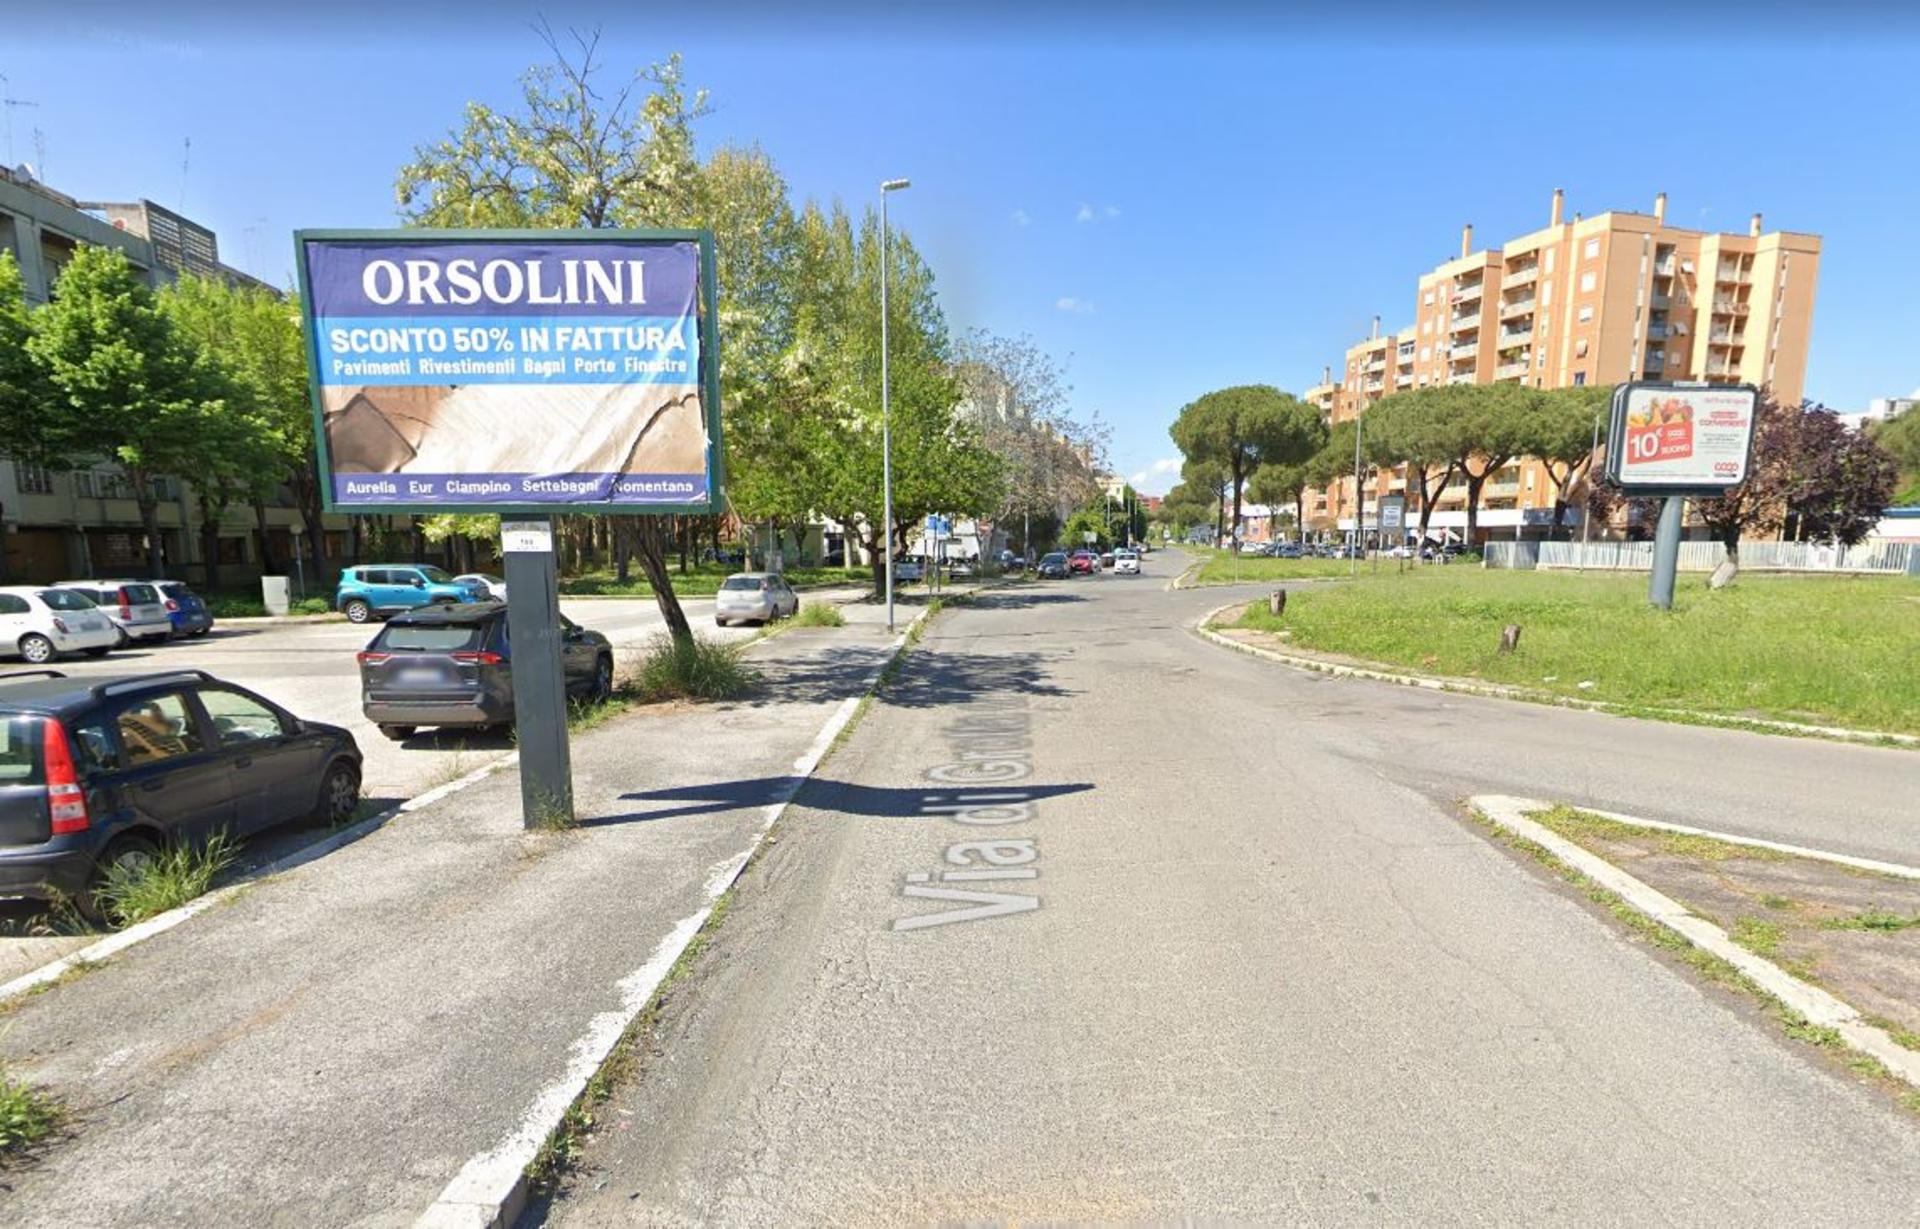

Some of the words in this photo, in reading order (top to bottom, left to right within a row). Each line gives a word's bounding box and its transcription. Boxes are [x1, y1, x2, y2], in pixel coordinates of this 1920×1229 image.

[362, 259, 646, 306] ORSOLINI
[331, 327, 447, 353] SCONTO
[453, 327, 514, 353] 50%
[521, 328, 549, 352] IN
[556, 327, 687, 351] FATTURA
[333, 358, 411, 376] Pavimenti
[419, 358, 516, 375] Rivestimenti
[524, 358, 566, 379] Bagni
[574, 358, 616, 374] Porte
[624, 357, 687, 373] Finestre
[347, 481, 397, 494] Aurelia
[409, 481, 434, 493] Eur
[446, 480, 512, 495] Ciampino
[522, 480, 599, 494] Settebagni
[615, 481, 693, 493] Nomentana
